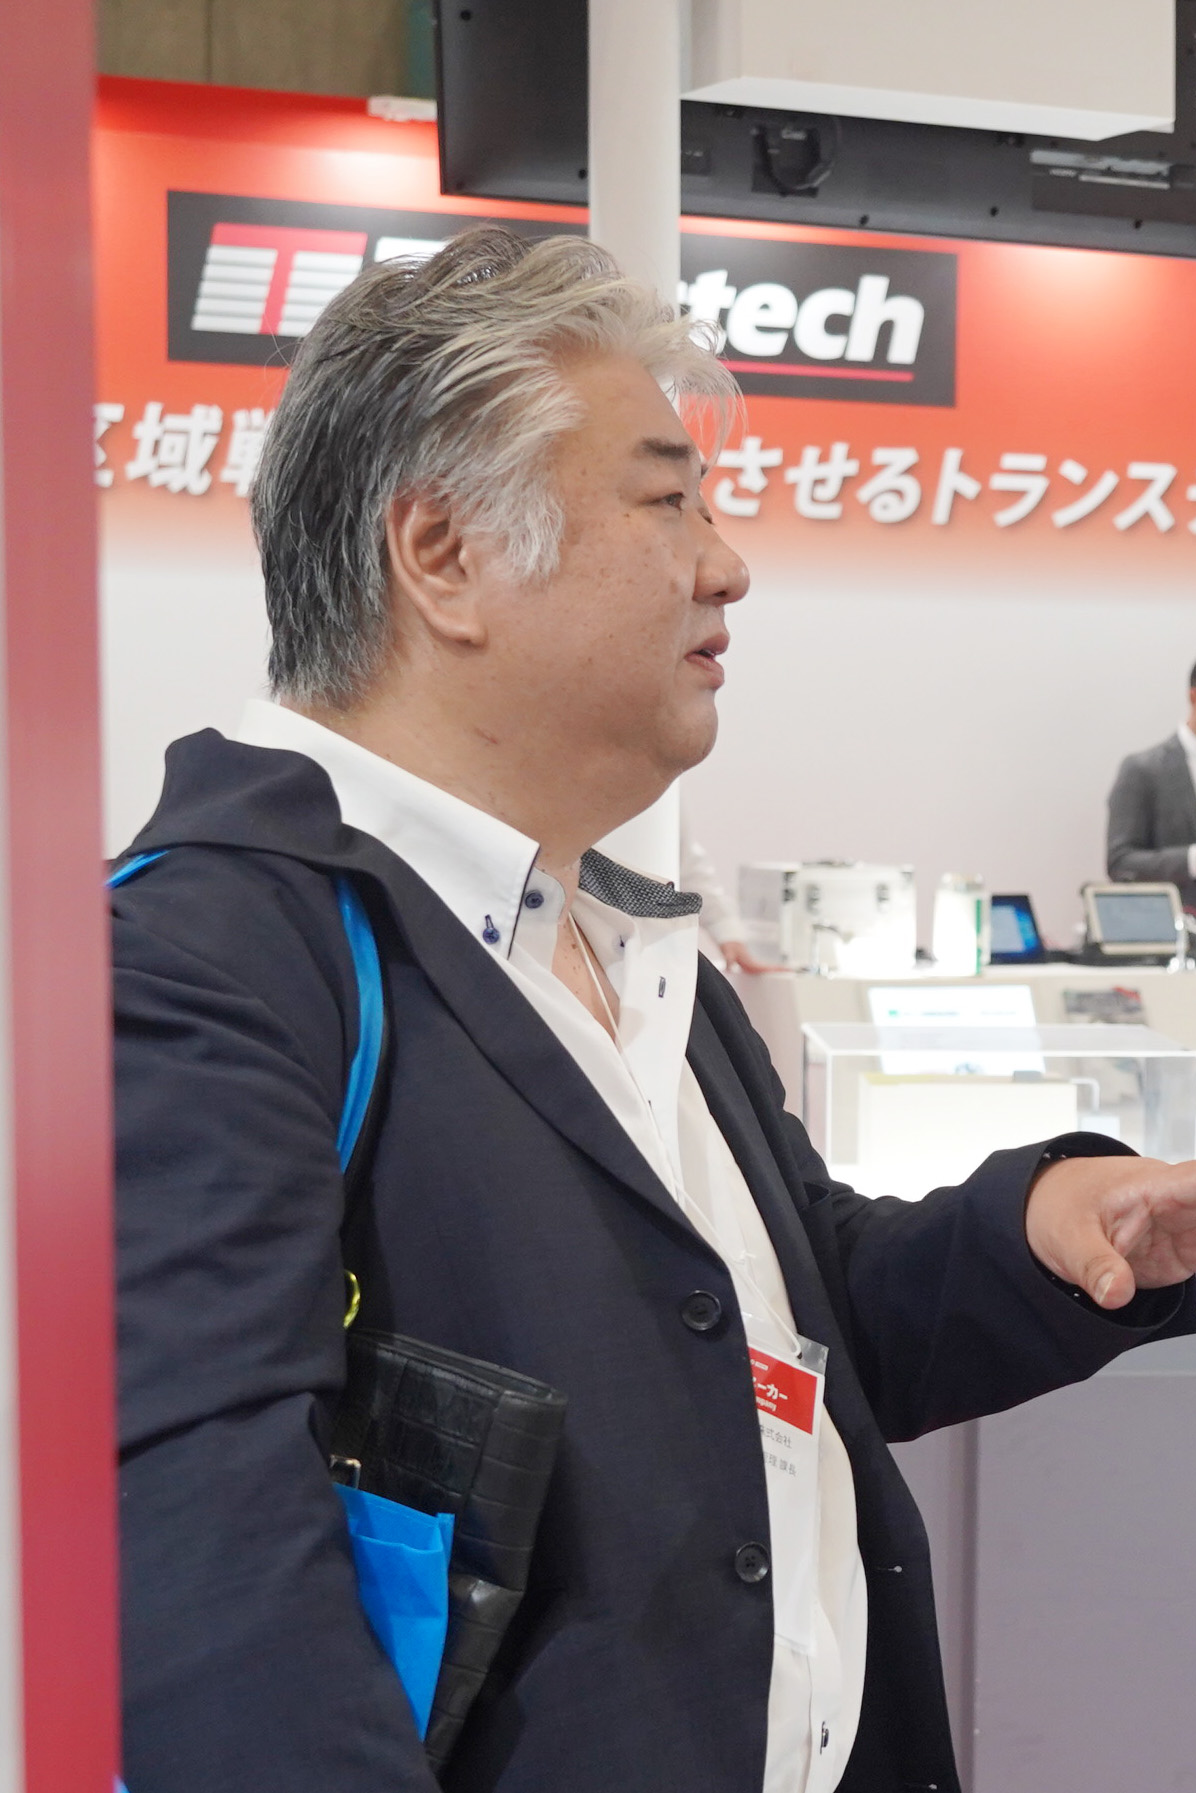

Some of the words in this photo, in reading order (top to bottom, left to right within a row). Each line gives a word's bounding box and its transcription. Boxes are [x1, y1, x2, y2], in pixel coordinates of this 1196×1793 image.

[677, 269, 925, 365] tech
[752, 1376, 788, 1400] ーカー
